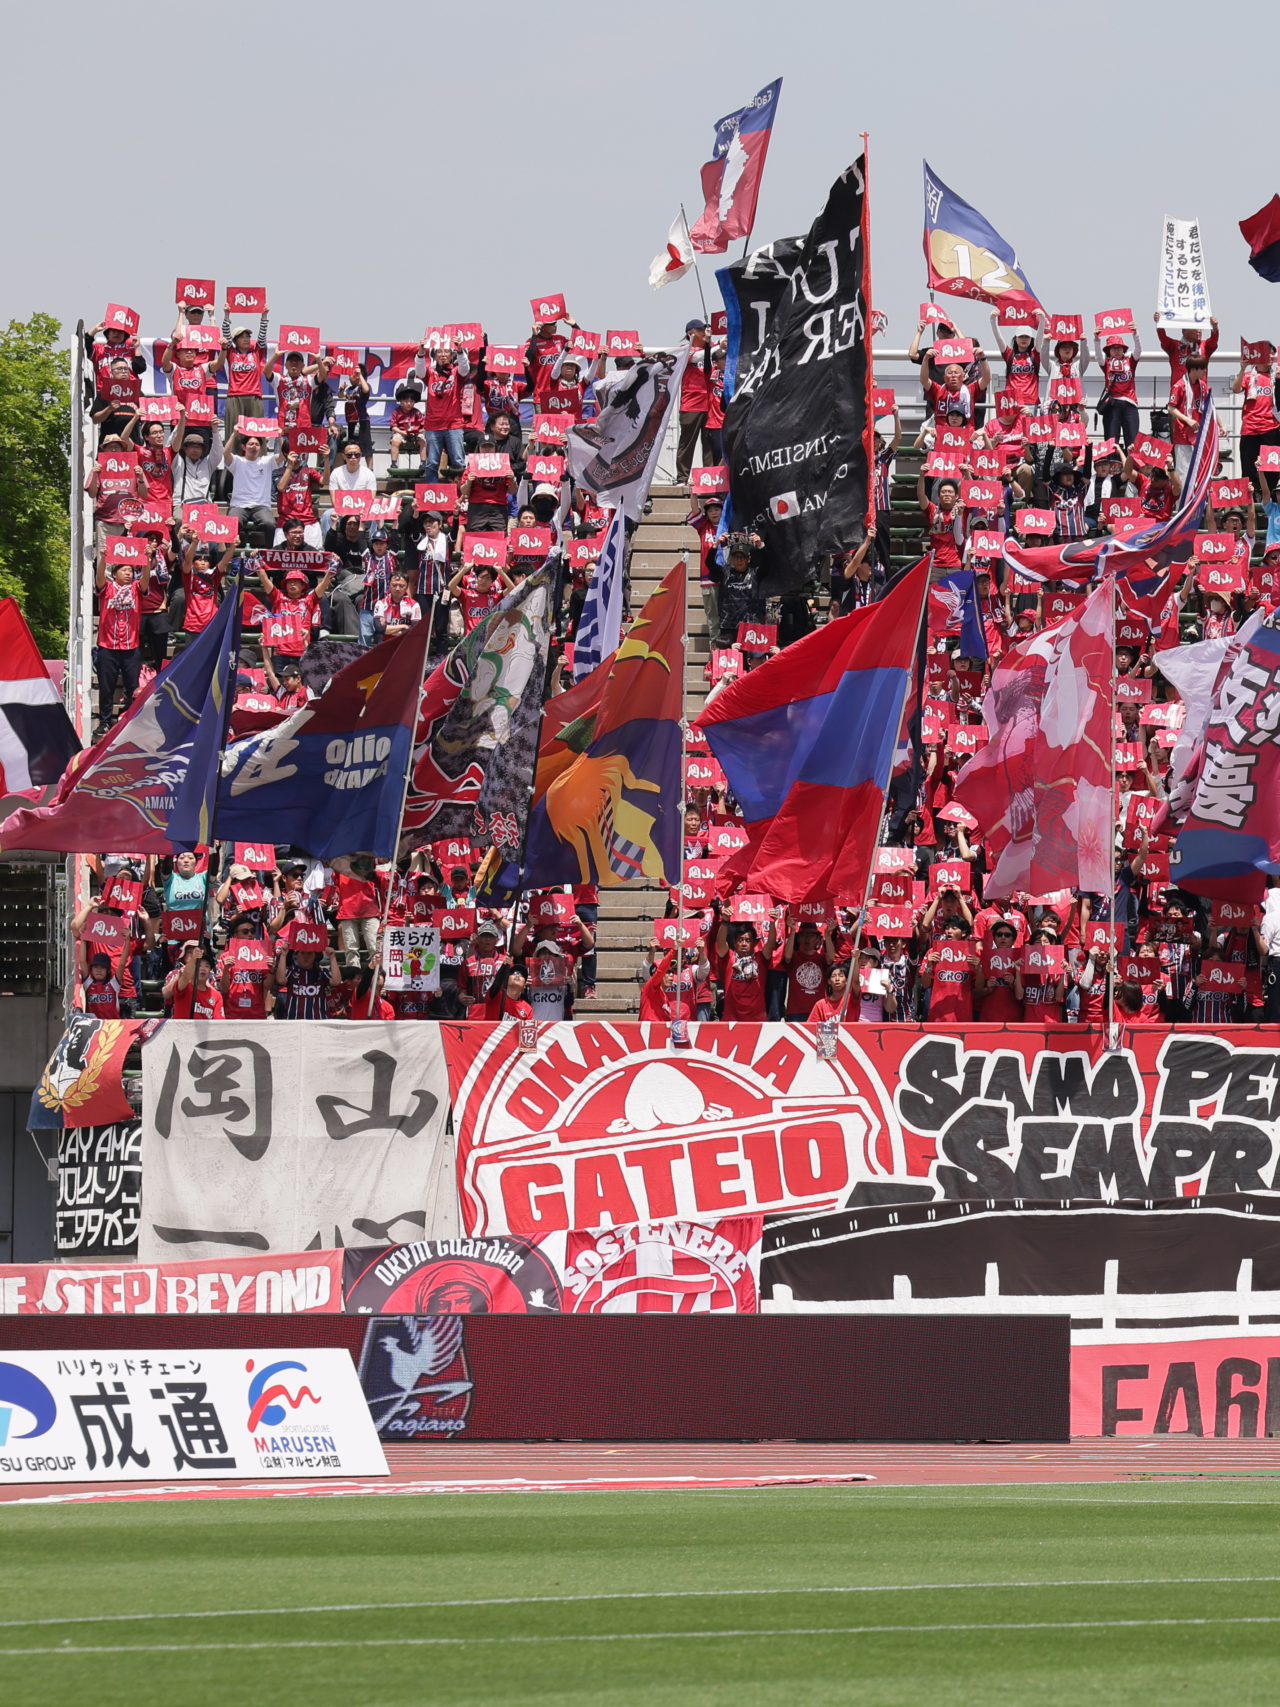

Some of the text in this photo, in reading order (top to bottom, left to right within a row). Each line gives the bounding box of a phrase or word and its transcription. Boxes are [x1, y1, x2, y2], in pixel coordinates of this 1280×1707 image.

[954, 243, 1012, 290] 12
[1176, 239, 1190, 308] するために
[1188, 225, 1206, 322] 君たちを後押し
[184, 285, 207, 298] 岡山
[1006, 306, 1027, 319] 岡山
[287, 331, 311, 345] 岡山
[493, 353, 516, 366] 岡山
[943, 432, 965, 446] 岡山
[295, 494, 304, 504] 12
[342, 495, 365, 508] 岡山
[1024, 514, 1047, 527] 岡山
[519, 534, 542, 548] 岡山
[1202, 540, 1226, 553] 岡山
[114, 543, 138, 557] 岡山
[266, 551, 324, 564] FAGIANO
[271, 623, 293, 637] 岡山
[745, 630, 768, 644] 岡山
[718, 833, 744, 847] 岡山
[92, 921, 117, 937] 岡山
[442, 916, 468, 930] 岡山
[391, 931, 434, 946] 我らが
[238, 946, 263, 961] 岡山
[941, 947, 966, 962] 岡山
[480, 963, 493, 975] 99
[1209, 968, 1234, 984] 岡山
[1025, 986, 1038, 998] 99
[523, 1032, 534, 1043] 12
[504, 1022, 805, 1132] OKAYAMA
[900, 1040, 1140, 1130] SIAMO
[155, 1039, 438, 1161] 岡山
[436, 1237, 526, 1275] Guardian
[40, 1269, 153, 1313] STEP
[161, 1265, 333, 1313] BEYOND
[57, 1358, 202, 1376] ハリウッドチェーン
[70, 1382, 237, 1472] 成通
[254, 1436, 336, 1454] MARUSEN
[26, 1456, 77, 1472] GROUP
